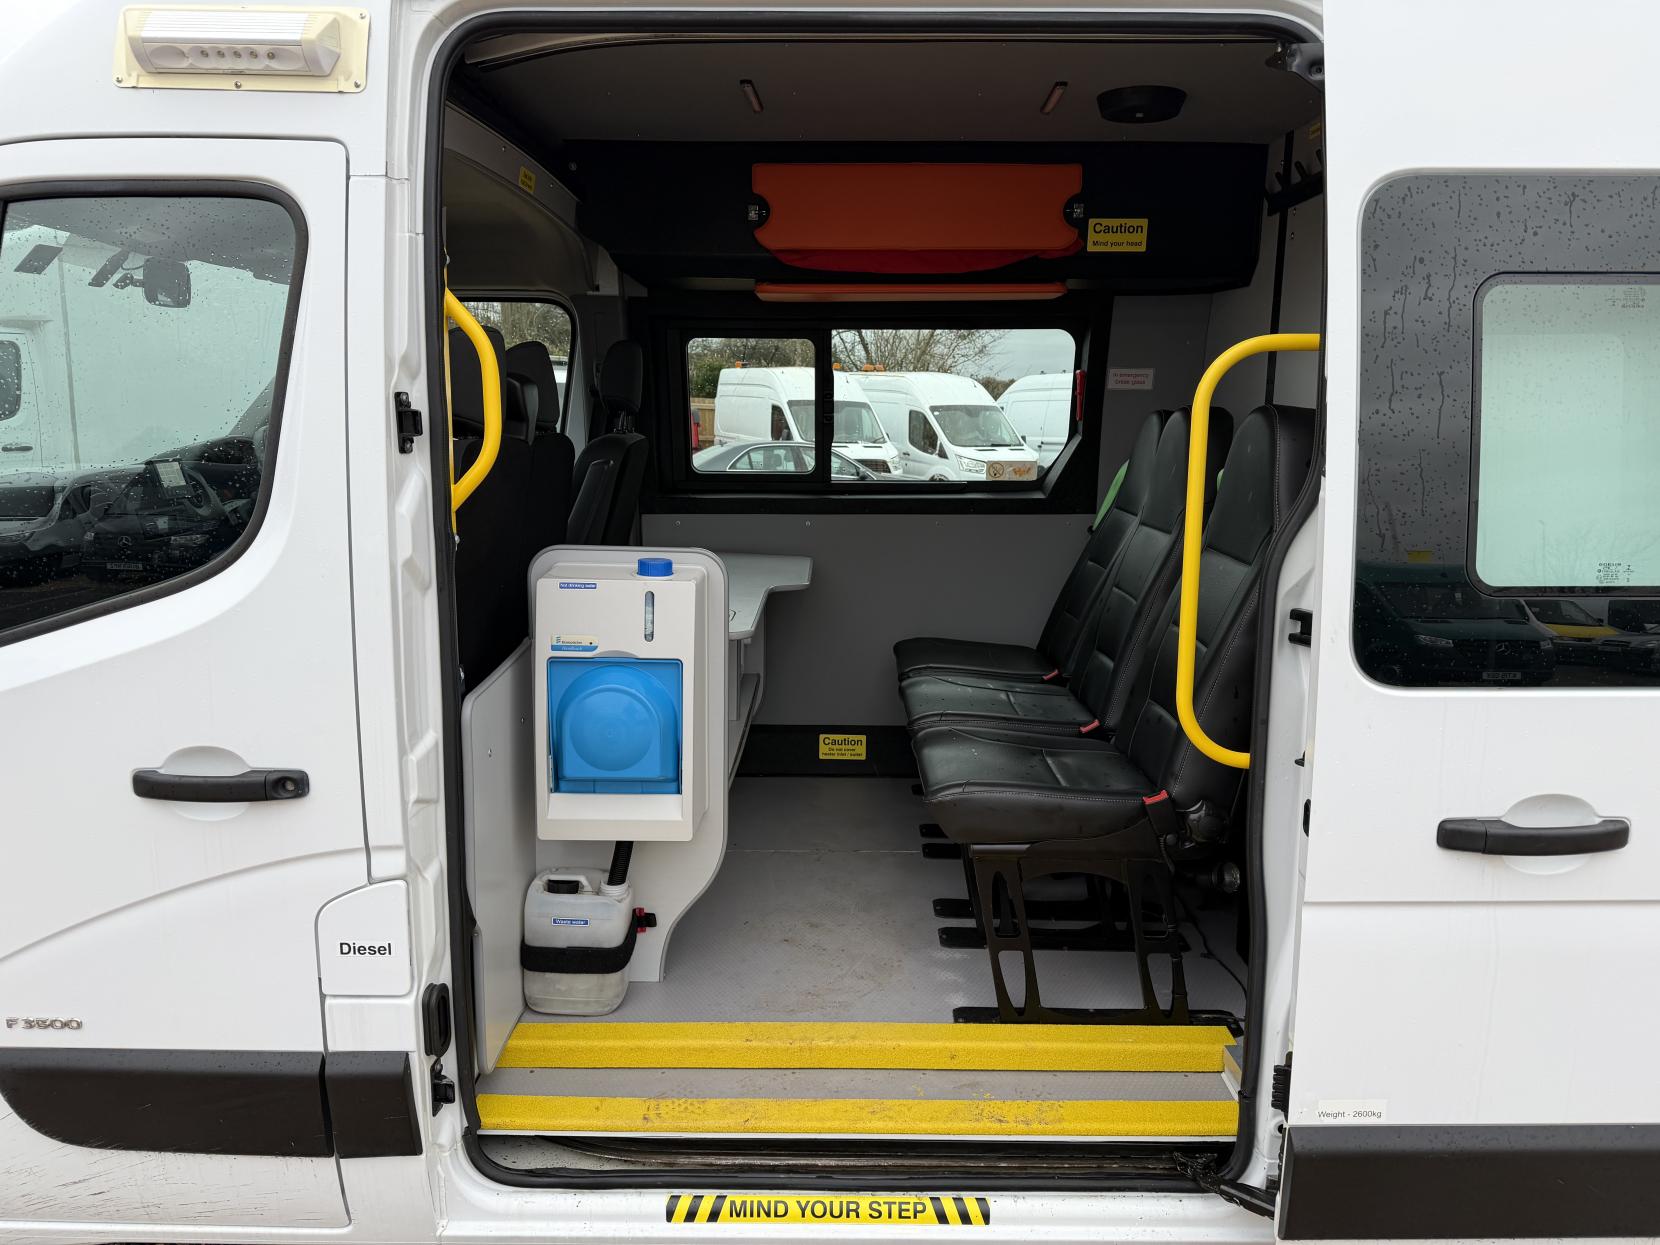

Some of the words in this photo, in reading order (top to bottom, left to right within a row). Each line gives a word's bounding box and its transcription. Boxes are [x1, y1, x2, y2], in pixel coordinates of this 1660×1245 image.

[1093, 222, 1144, 234] Caution
[822, 736, 863, 746] Caution
[339, 942, 392, 956] Diesel
[1317, 1111, 1345, 1120] Weight
[1352, 1110, 1382, 1119] 2600kg
[729, 1199, 789, 1219] MIND
[799, 1199, 861, 1219] YOUR
[868, 1200, 928, 1220] STEP
